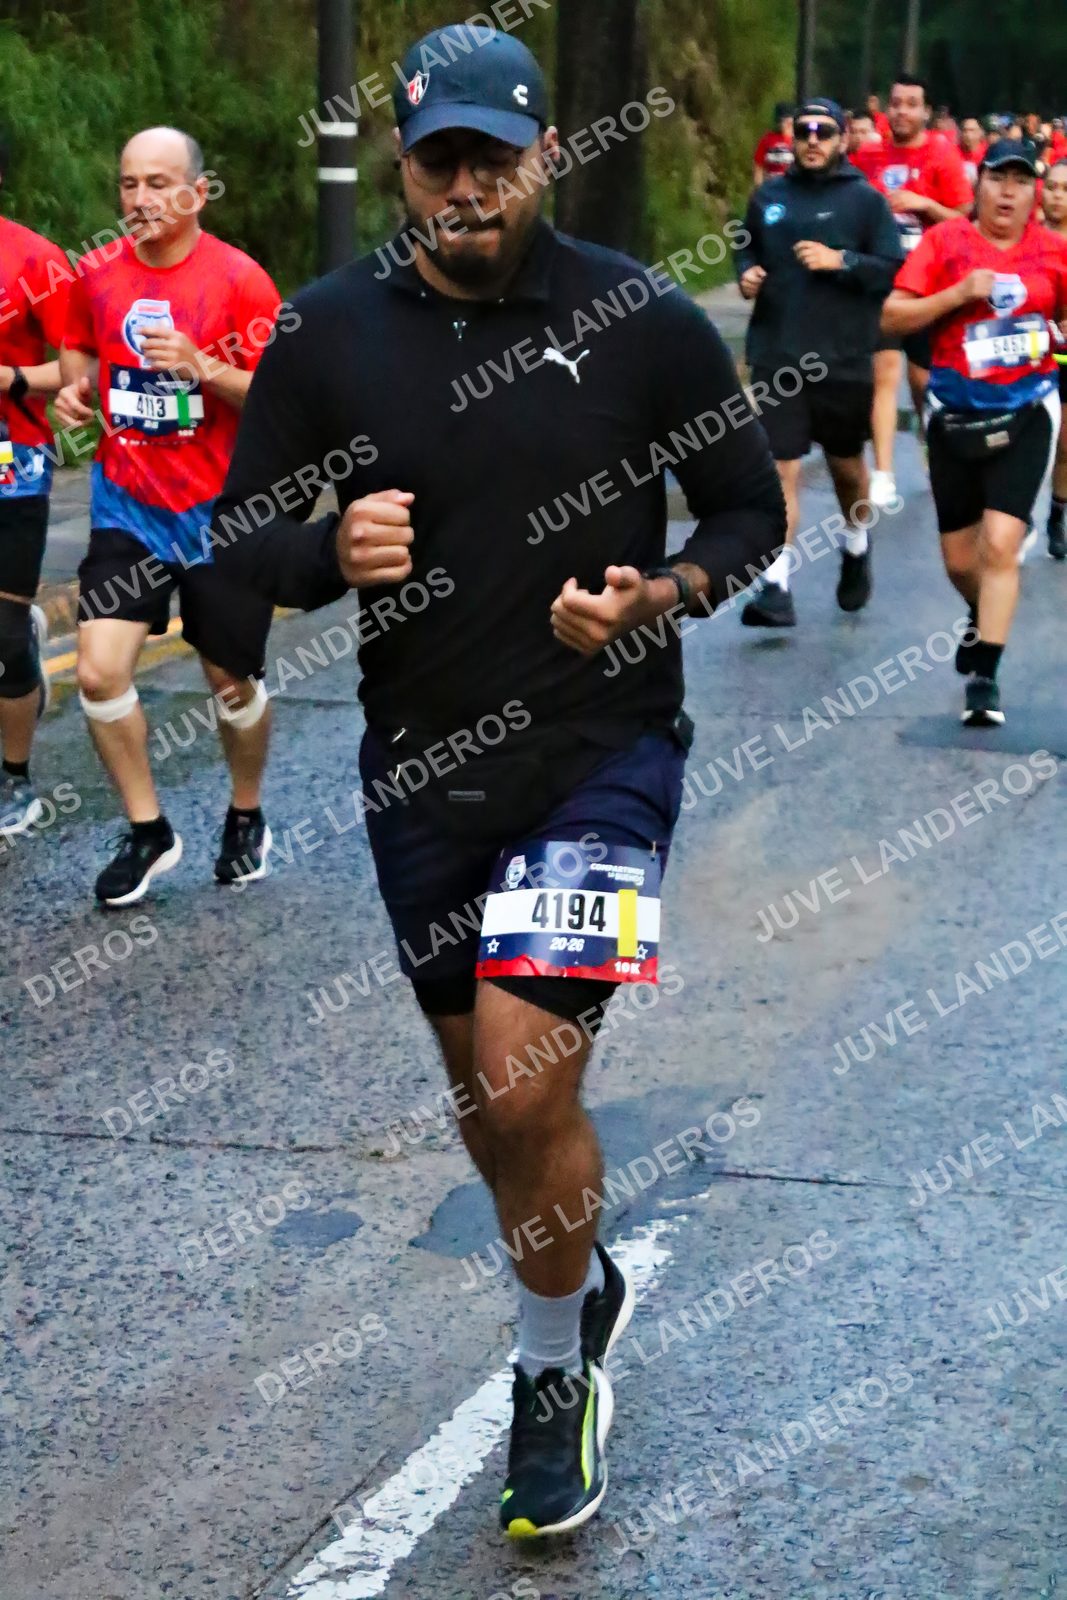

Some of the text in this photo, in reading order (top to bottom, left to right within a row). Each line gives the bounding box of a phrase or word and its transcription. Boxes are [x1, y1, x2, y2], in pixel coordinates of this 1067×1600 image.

[136, 394, 166, 418] 4113
[531, 892, 606, 932] 4194
[614, 961, 642, 975] 10K
